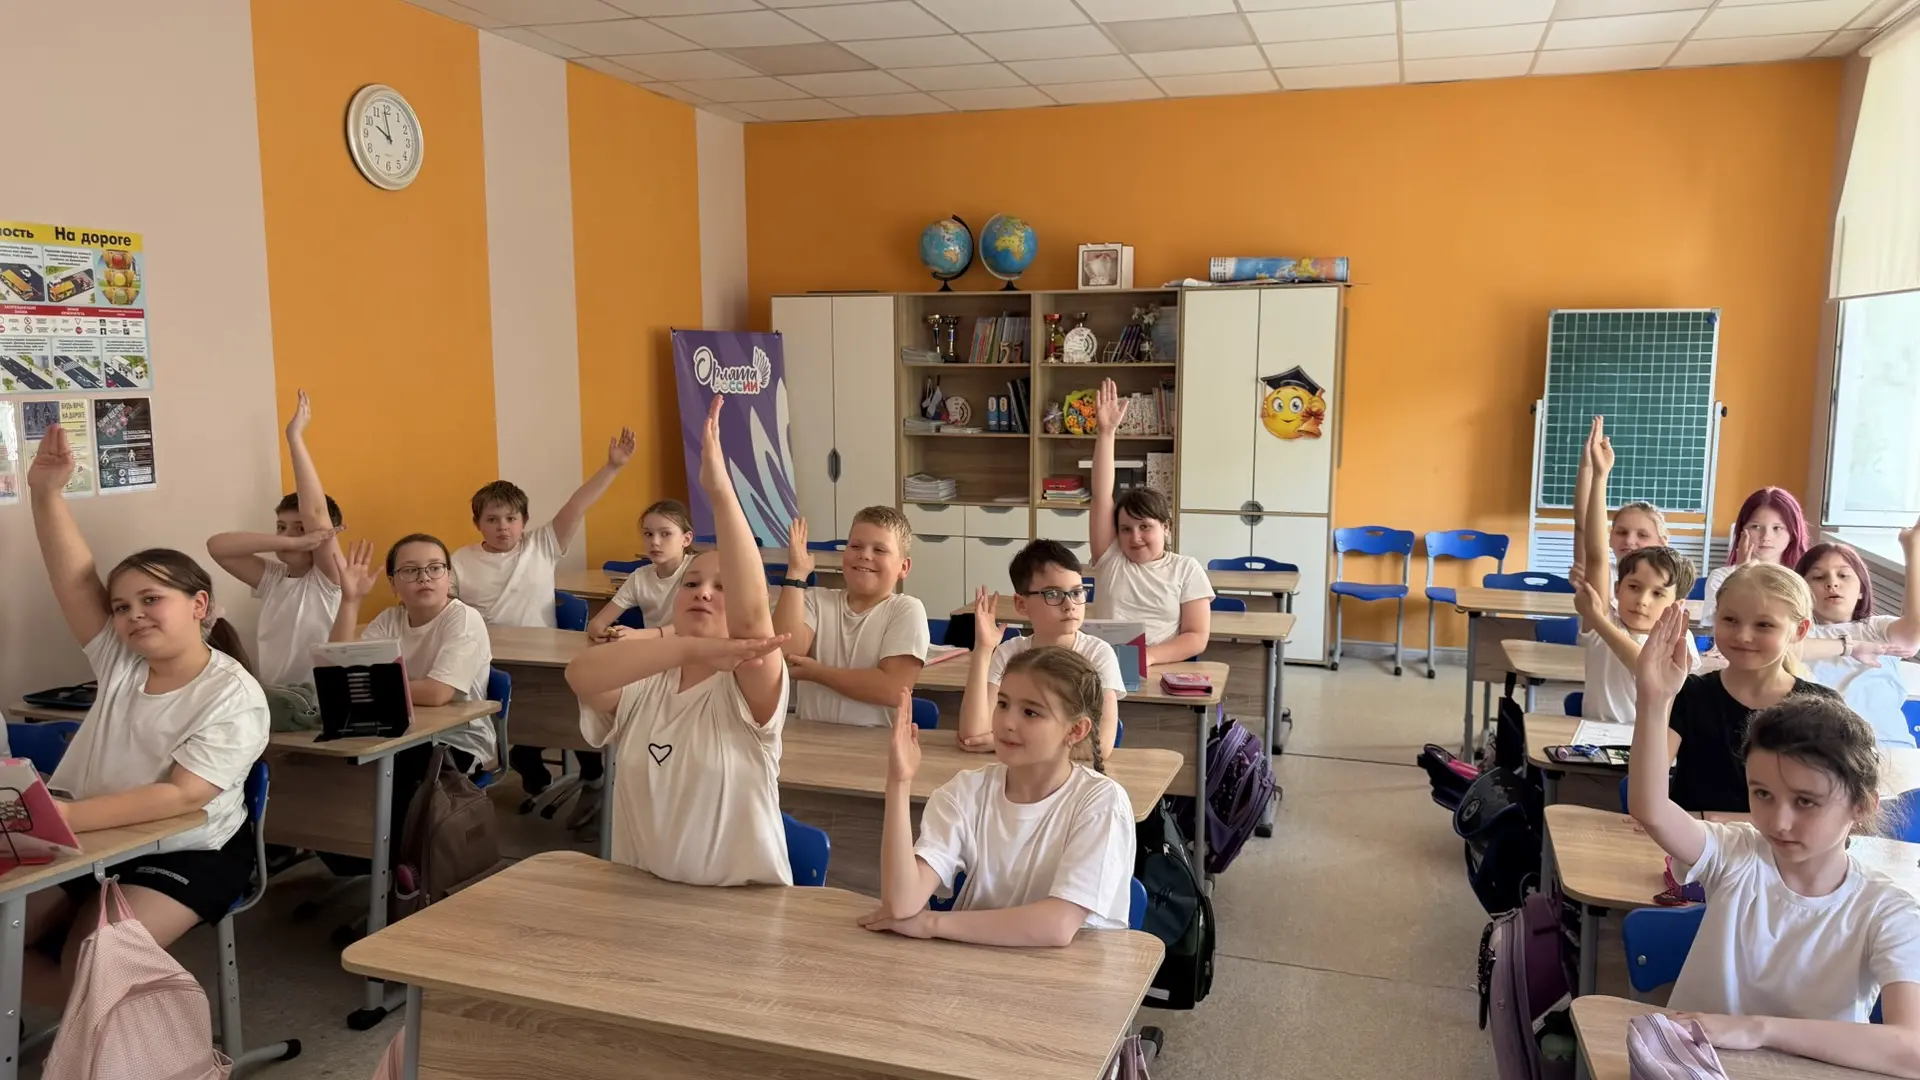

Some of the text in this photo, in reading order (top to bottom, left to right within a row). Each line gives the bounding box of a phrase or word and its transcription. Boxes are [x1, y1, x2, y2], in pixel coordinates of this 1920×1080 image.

[0, 226, 132, 247] ость На дороге
[695, 346, 759, 391] Орлята
[715, 380, 759, 392] РОССИИ
